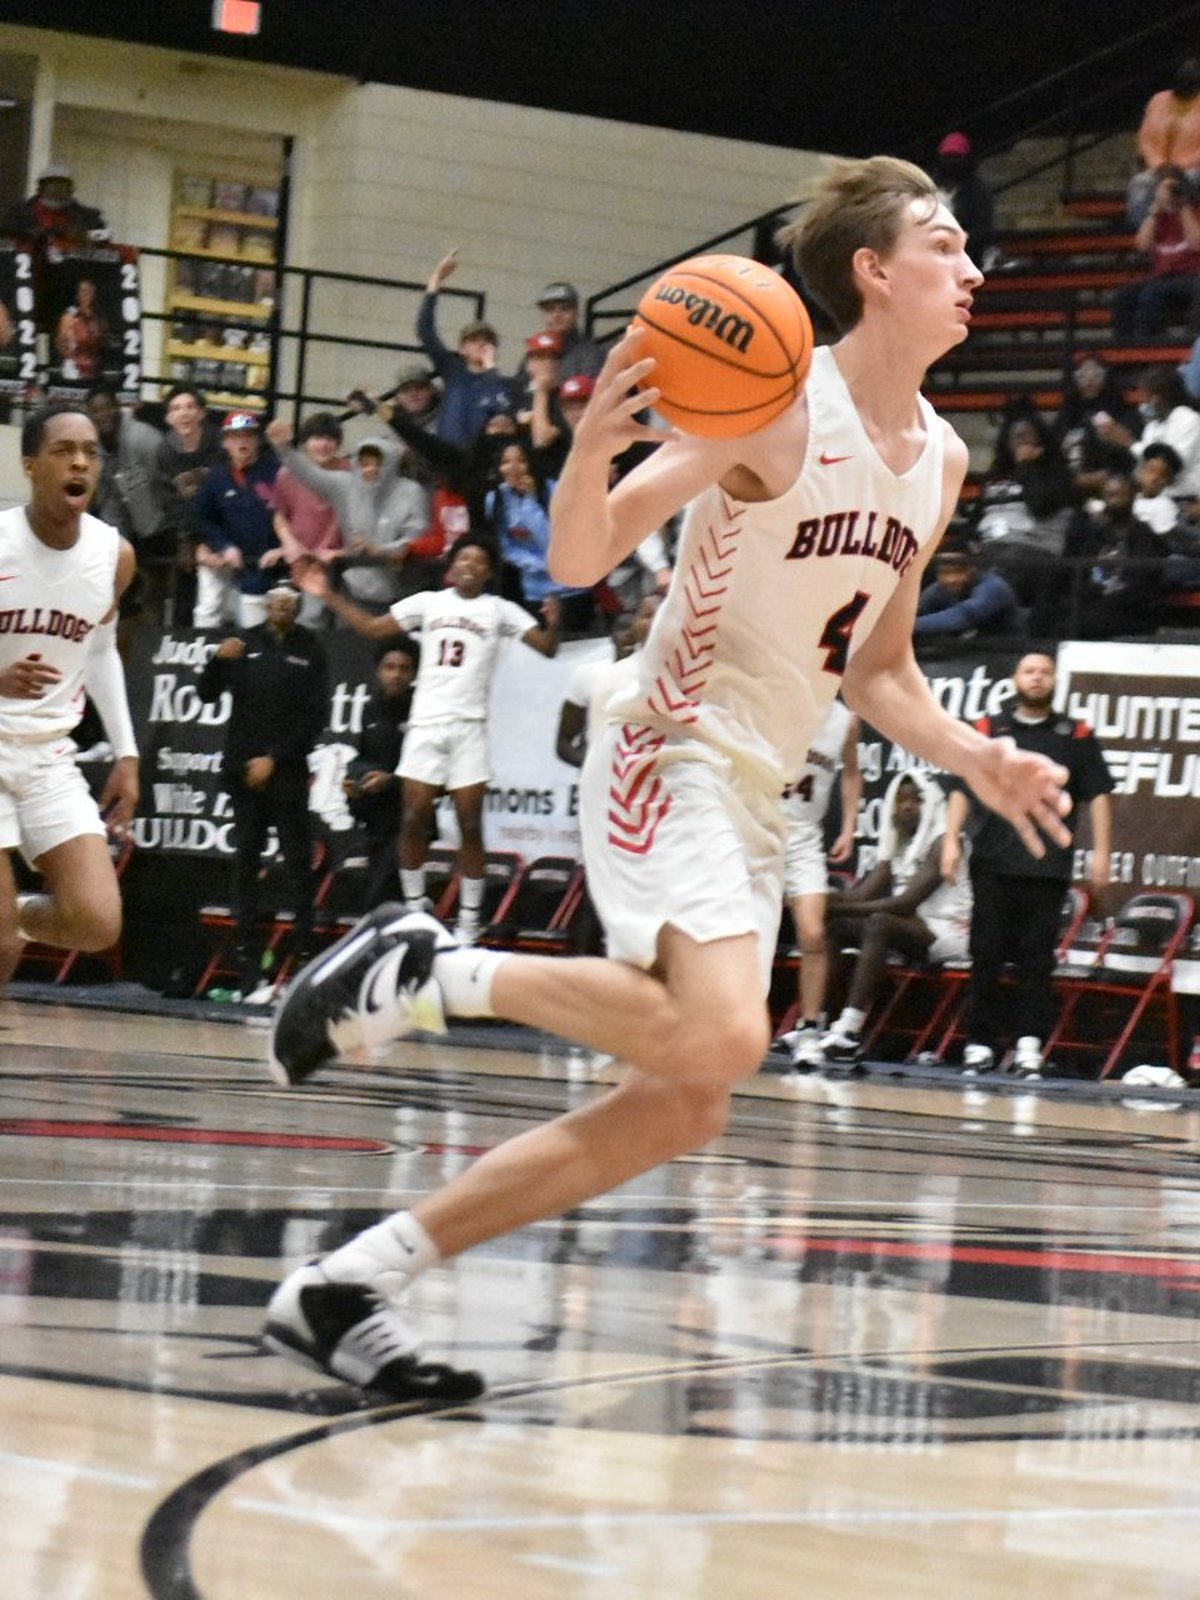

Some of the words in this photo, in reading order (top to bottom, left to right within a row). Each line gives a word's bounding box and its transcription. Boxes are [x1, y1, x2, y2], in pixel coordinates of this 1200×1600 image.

[15, 252, 38, 379] 2022
[120, 263, 141, 391] 2022
[655, 282, 755, 354] Wilson
[784, 510, 919, 578] BULLDO
[0, 608, 94, 643] ULLDOG
[152, 634, 220, 674] Judg
[439, 638, 465, 667] 13
[817, 589, 872, 678] 4
